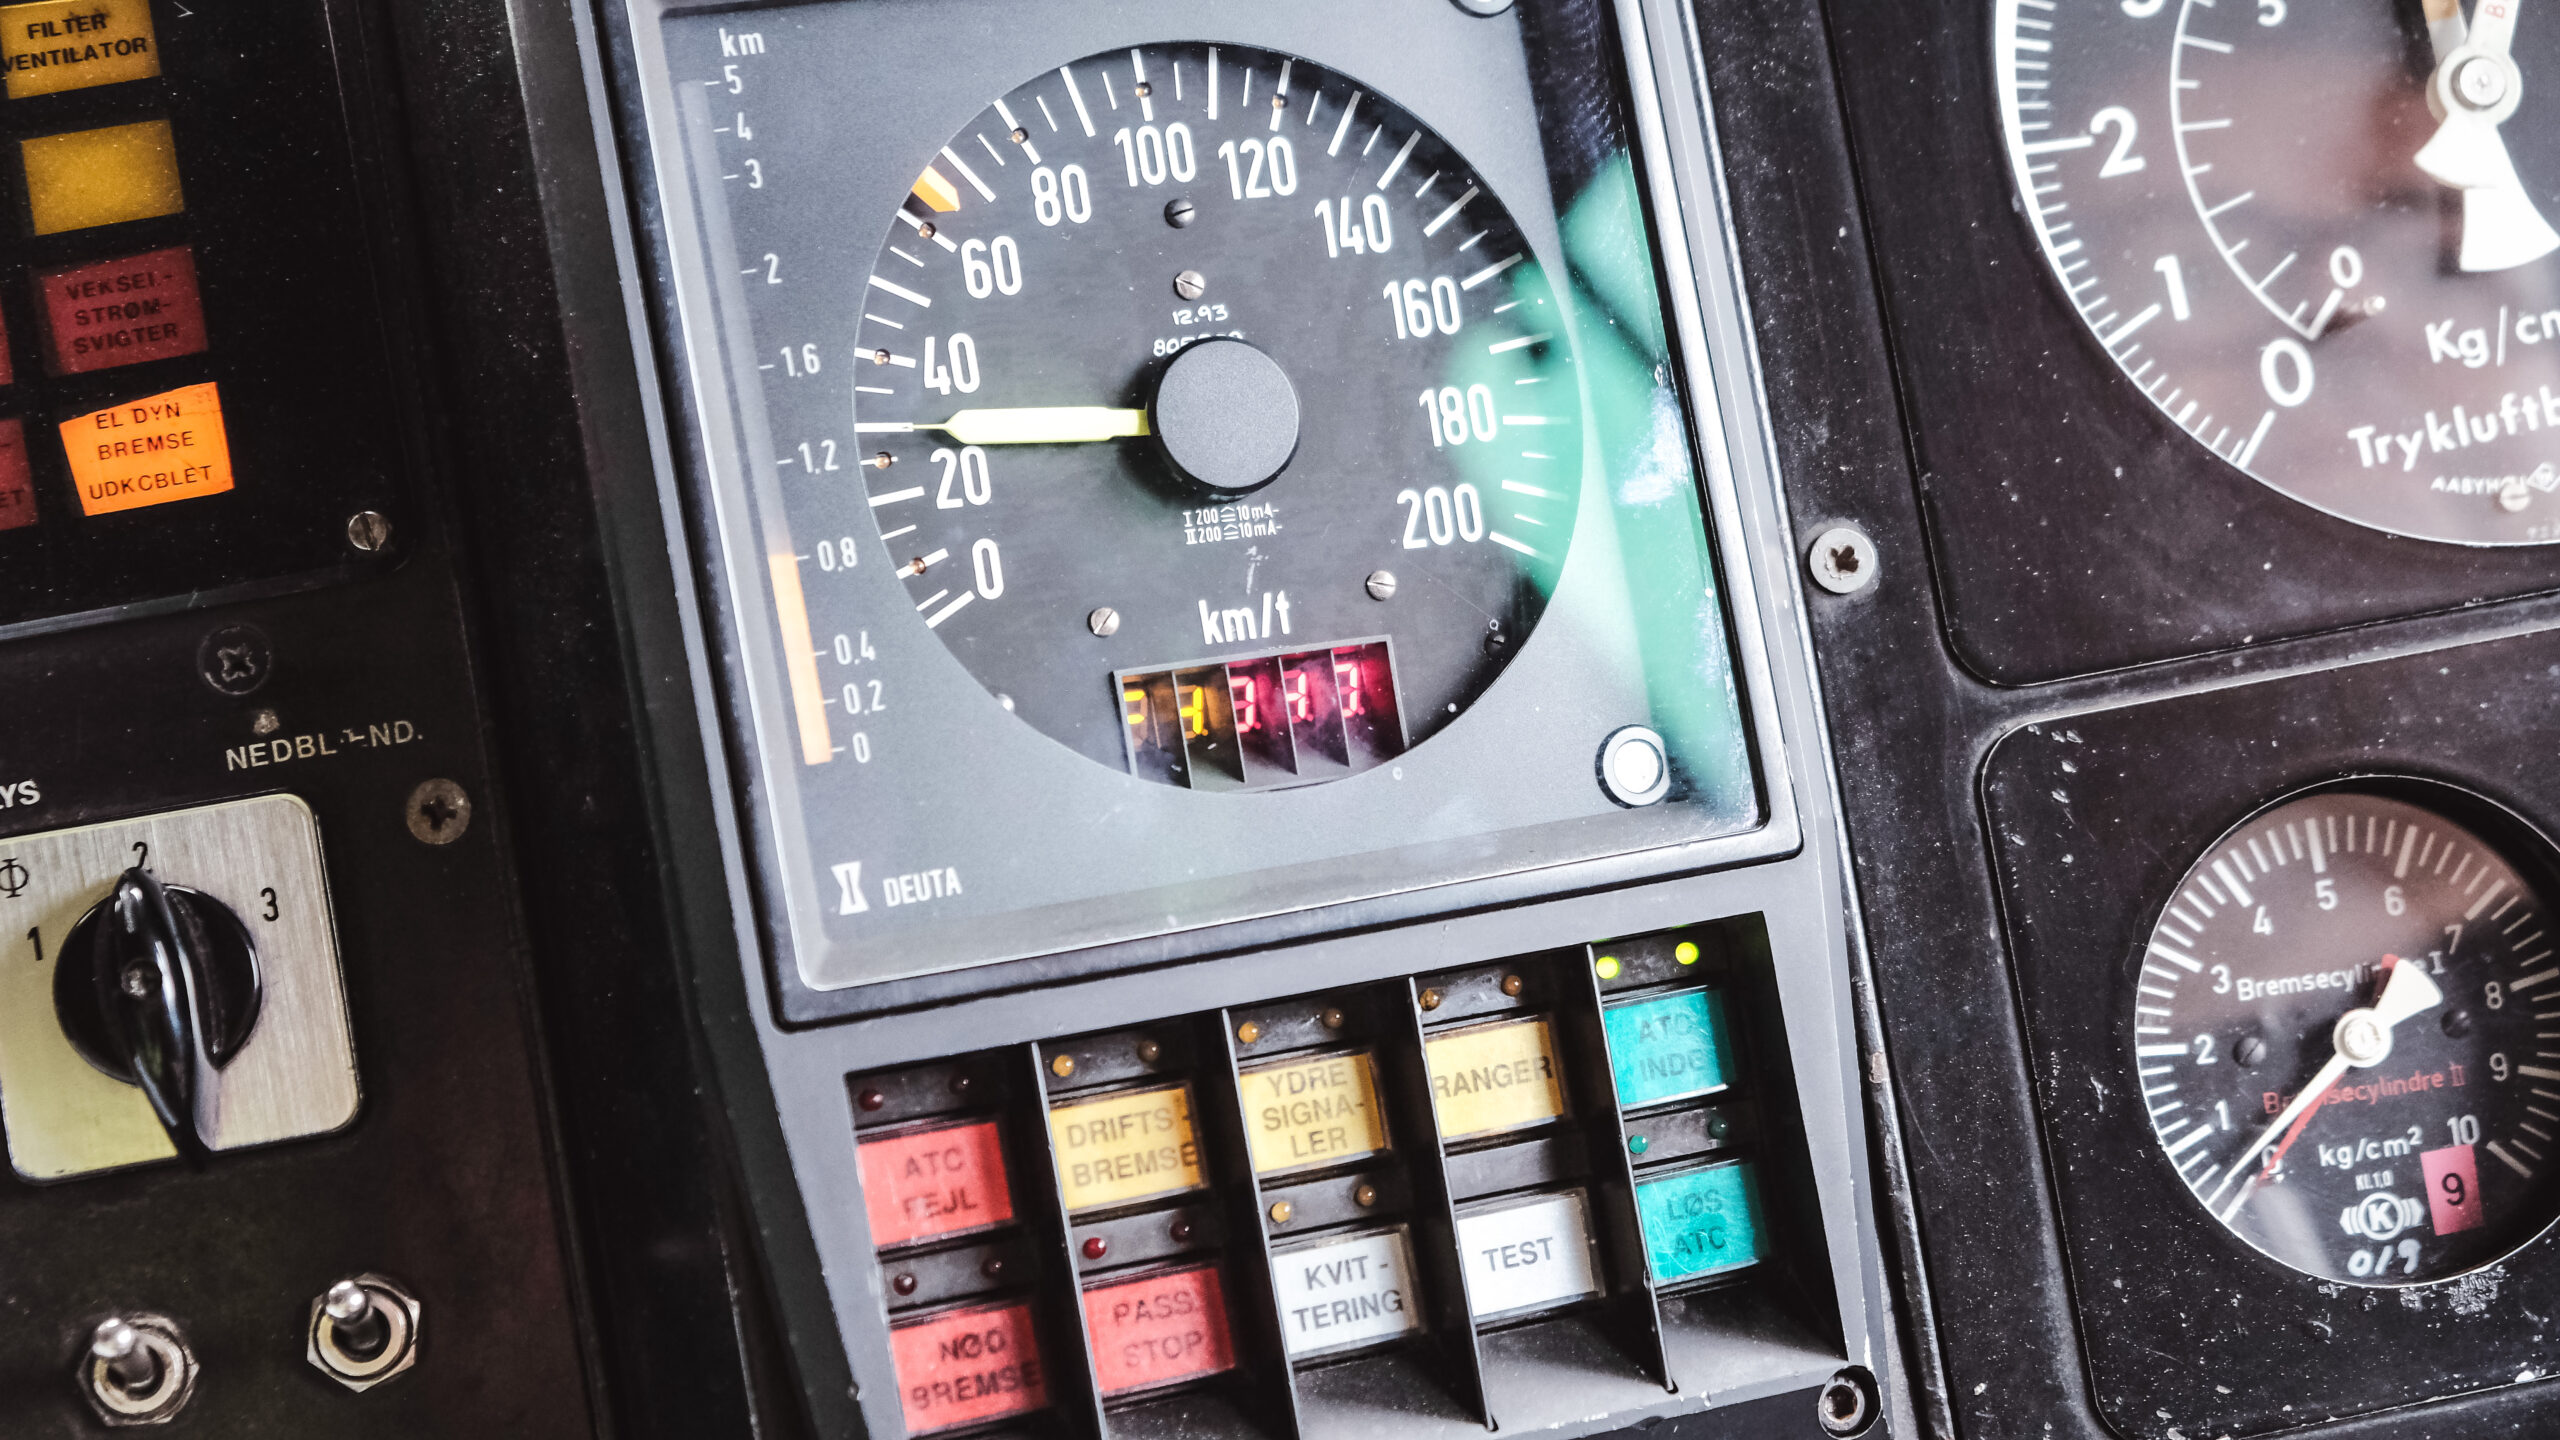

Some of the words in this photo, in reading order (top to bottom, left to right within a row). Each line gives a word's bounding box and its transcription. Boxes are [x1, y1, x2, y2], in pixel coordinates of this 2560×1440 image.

[28, 12, 107, 39] FILTER
[718, 28, 766, 57] km
[2, 37, 147, 73] VENTILATOR
[724, 65, 743, 94] 5
[737, 112, 752, 141] 4
[2090, 105, 2146, 178] 2
[1113, 121, 1196, 188] 100
[1218, 136, 1297, 200] 120
[744, 158, 763, 189] 3
[1031, 164, 1092, 227] 80
[1314, 194, 1392, 258] 140
[763, 253, 783, 285] 2
[961, 236, 1023, 299] 60
[2329, 246, 2363, 289] 0
[2153, 254, 2191, 321] 1
[1172, 304, 1229, 326] 12.93
[1383, 276, 1461, 340] 160
[73, 322, 178, 354] SVIGTER
[924, 332, 980, 396] 40
[2260, 338, 2315, 407] 0
[96, 413, 123, 430] EL
[133, 402, 181, 424] DYN
[1418, 384, 1498, 447] 180
[98, 430, 195, 460] BREMSE
[930, 445, 992, 509] 20
[1397, 483, 1484, 549] 200
[971, 538, 1004, 600] 0
[1198, 590, 1291, 645] km/t
[852, 731, 871, 764] 0
[132, 841, 153, 873] 2
[882, 866, 963, 908] DEUTA
[2315, 879, 2339, 911] 5
[2384, 885, 2405, 916] 6
[260, 887, 280, 922] 3
[2252, 905, 2274, 936] 4
[26, 925, 44, 962] 1
[2444, 923, 2465, 955] 7
[2211, 964, 2233, 995] 3
[2484, 982, 2503, 1011] 8
[1639, 1012, 1692, 1045] ATC
[2194, 1033, 2218, 1065] 2
[1267, 1062, 1349, 1097] YDRE
[1432, 1055, 1554, 1100] RANGER
[2489, 1052, 2509, 1082] 9
[1262, 1099, 1366, 1133] SIGNA-
[2214, 1100, 2231, 1131] 1
[2446, 1114, 2481, 1147] 10
[1289, 1126, 1349, 1160] LER
[905, 1147, 966, 1179] ATC
[1071, 1141, 1200, 1189] BREMSE
[2441, 1172, 2466, 1206] 9
[2367, 1202, 2395, 1232] K
[1481, 1237, 1553, 1273] TEST
[1674, 1224, 1727, 1259] ATC
[1292, 1289, 1404, 1334] TERING
[1124, 1329, 1205, 1369] STOP
[911, 1360, 1041, 1411] BREMSE
